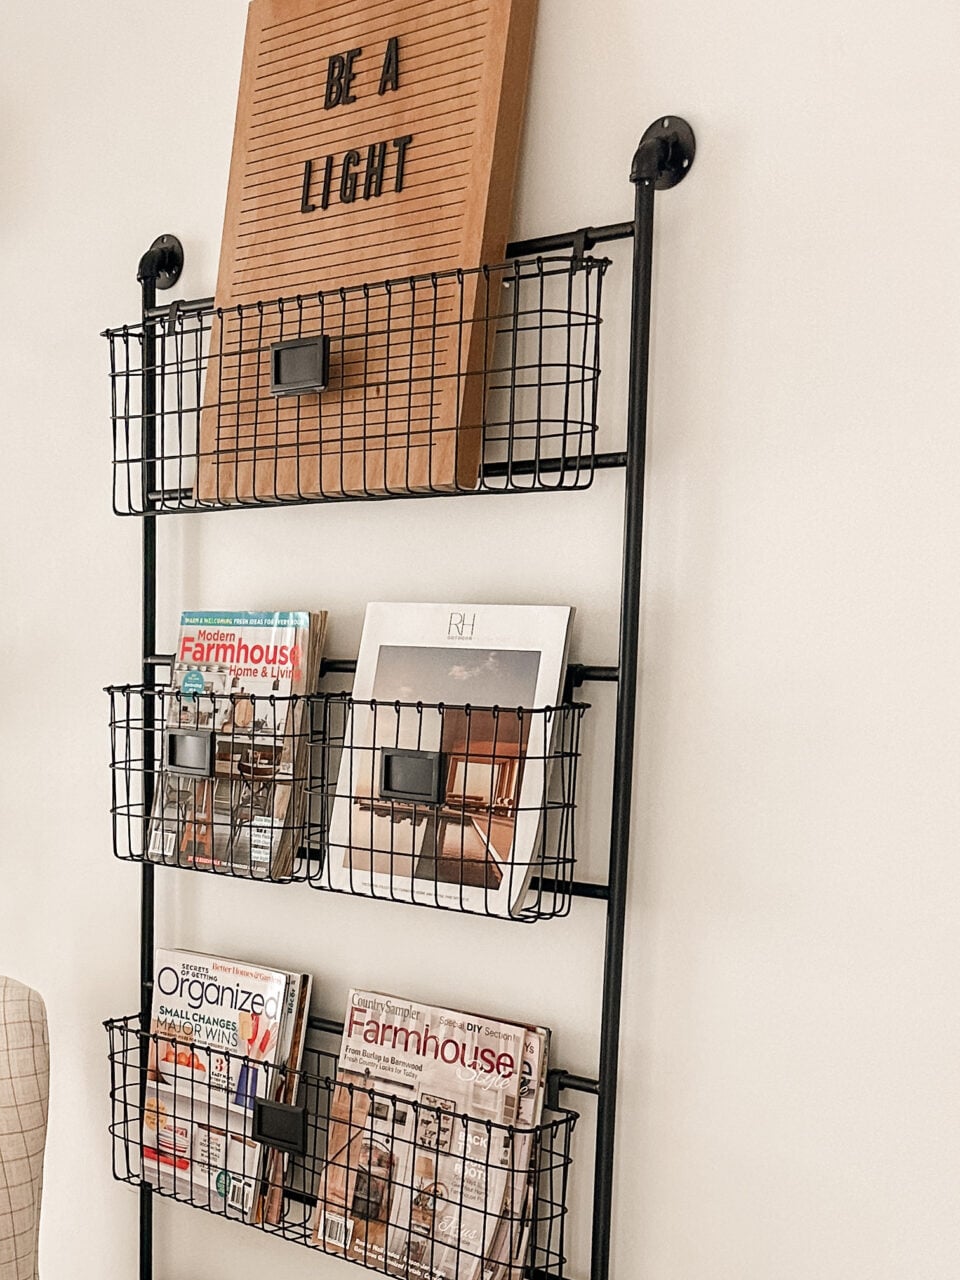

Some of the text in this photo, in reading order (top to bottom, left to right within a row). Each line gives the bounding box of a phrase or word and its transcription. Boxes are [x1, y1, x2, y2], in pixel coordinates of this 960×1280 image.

[324, 37, 400, 111] BE A
[301, 135, 413, 214] LIGHT
[198, 629, 236, 643] Modern
[448, 612, 476, 636] RH
[180, 636, 303, 668] Farmhouse
[229, 664, 259, 679] Home
[261, 666, 268, 678] &
[182, 963, 209, 974] SECRETS
[191, 972, 218, 983] GETTING
[158, 966, 281, 1021] Organized
[159, 1005, 191, 1021] SMALL
[156, 1016, 238, 1048] MAJOR WINS
[466, 1022, 483, 1034] DIY
[348, 1006, 515, 1079] Farmhouse
[345, 1045, 361, 1056] From
[362, 1048, 382, 1063] Burlap
[391, 1056, 423, 1072] Barnwood
[359, 1057, 378, 1071] Country
[379, 1063, 394, 1073] Looks
[403, 1069, 418, 1081] Today
[456, 1060, 512, 1090] Style
